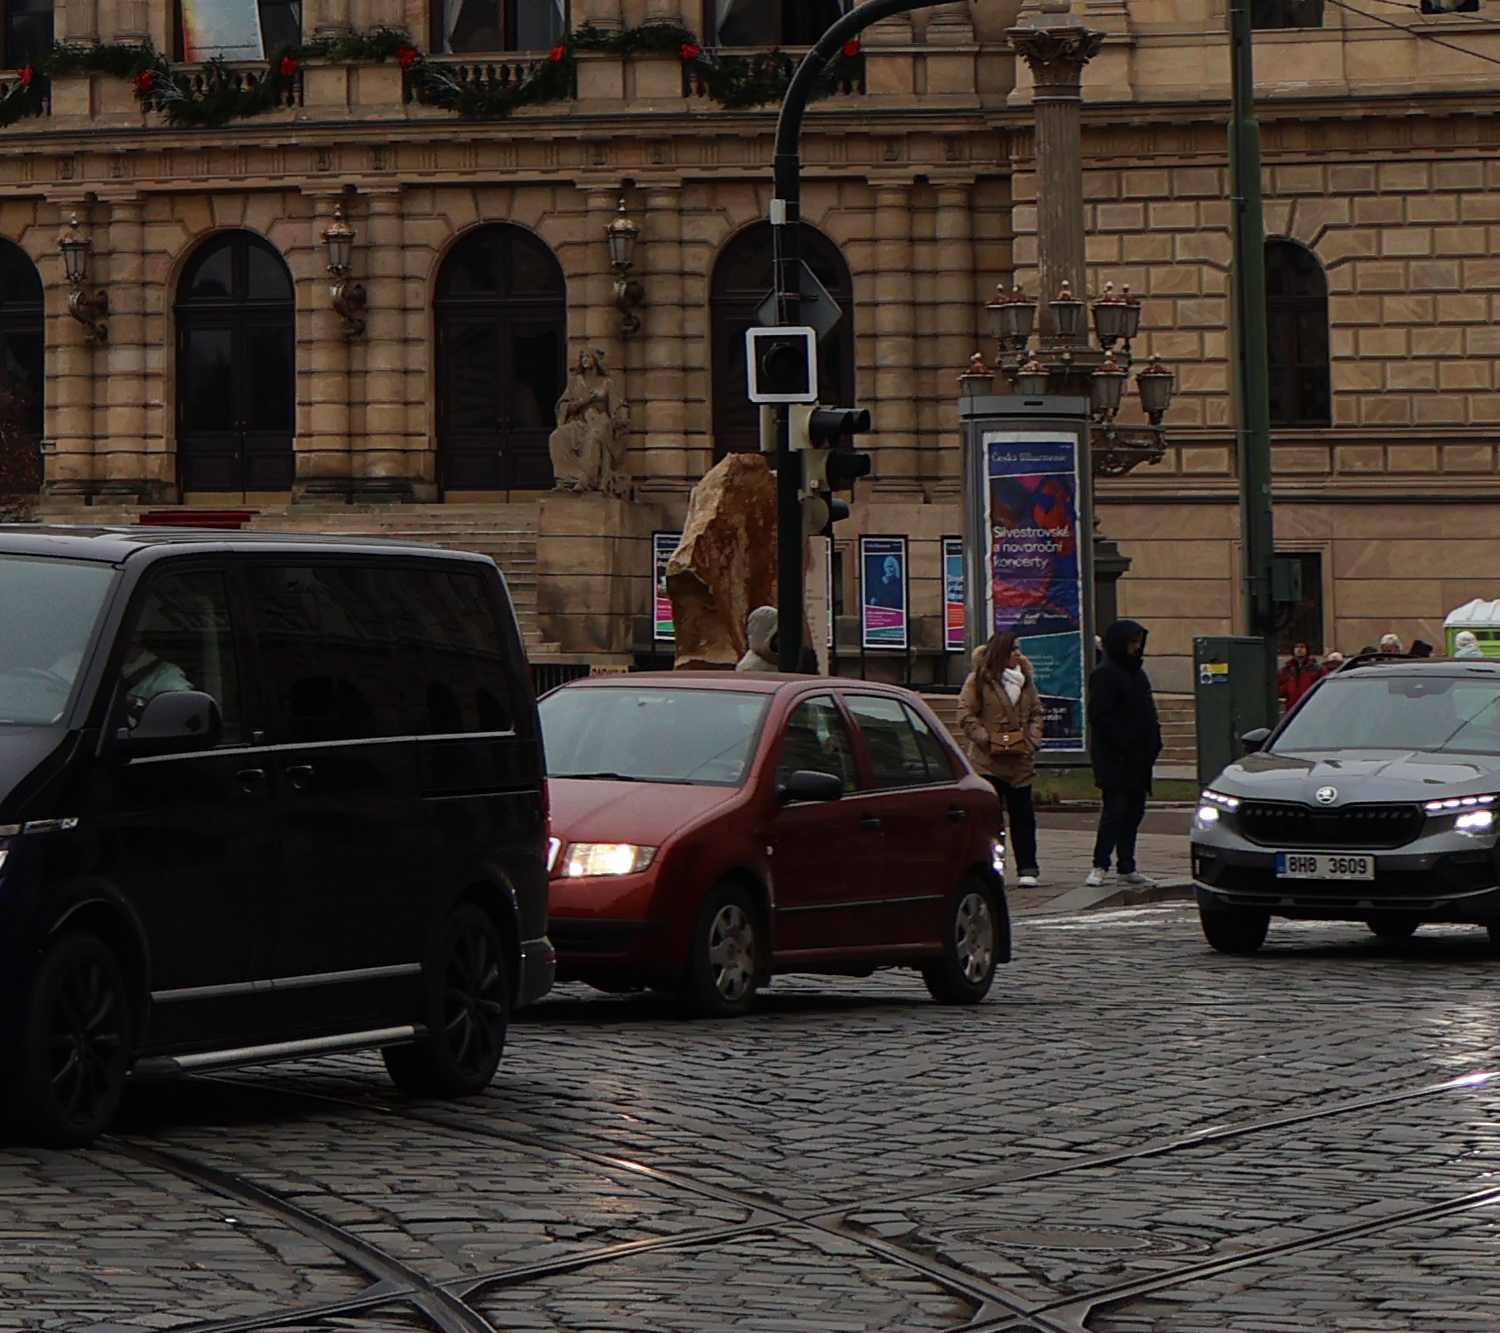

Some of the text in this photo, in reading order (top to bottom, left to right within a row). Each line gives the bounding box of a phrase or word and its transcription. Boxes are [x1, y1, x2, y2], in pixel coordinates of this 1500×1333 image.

[1003, 540, 1063, 553] novoroční
[993, 555, 1049, 570] koncerty
[1289, 856, 1367, 874] 8H8 3609
